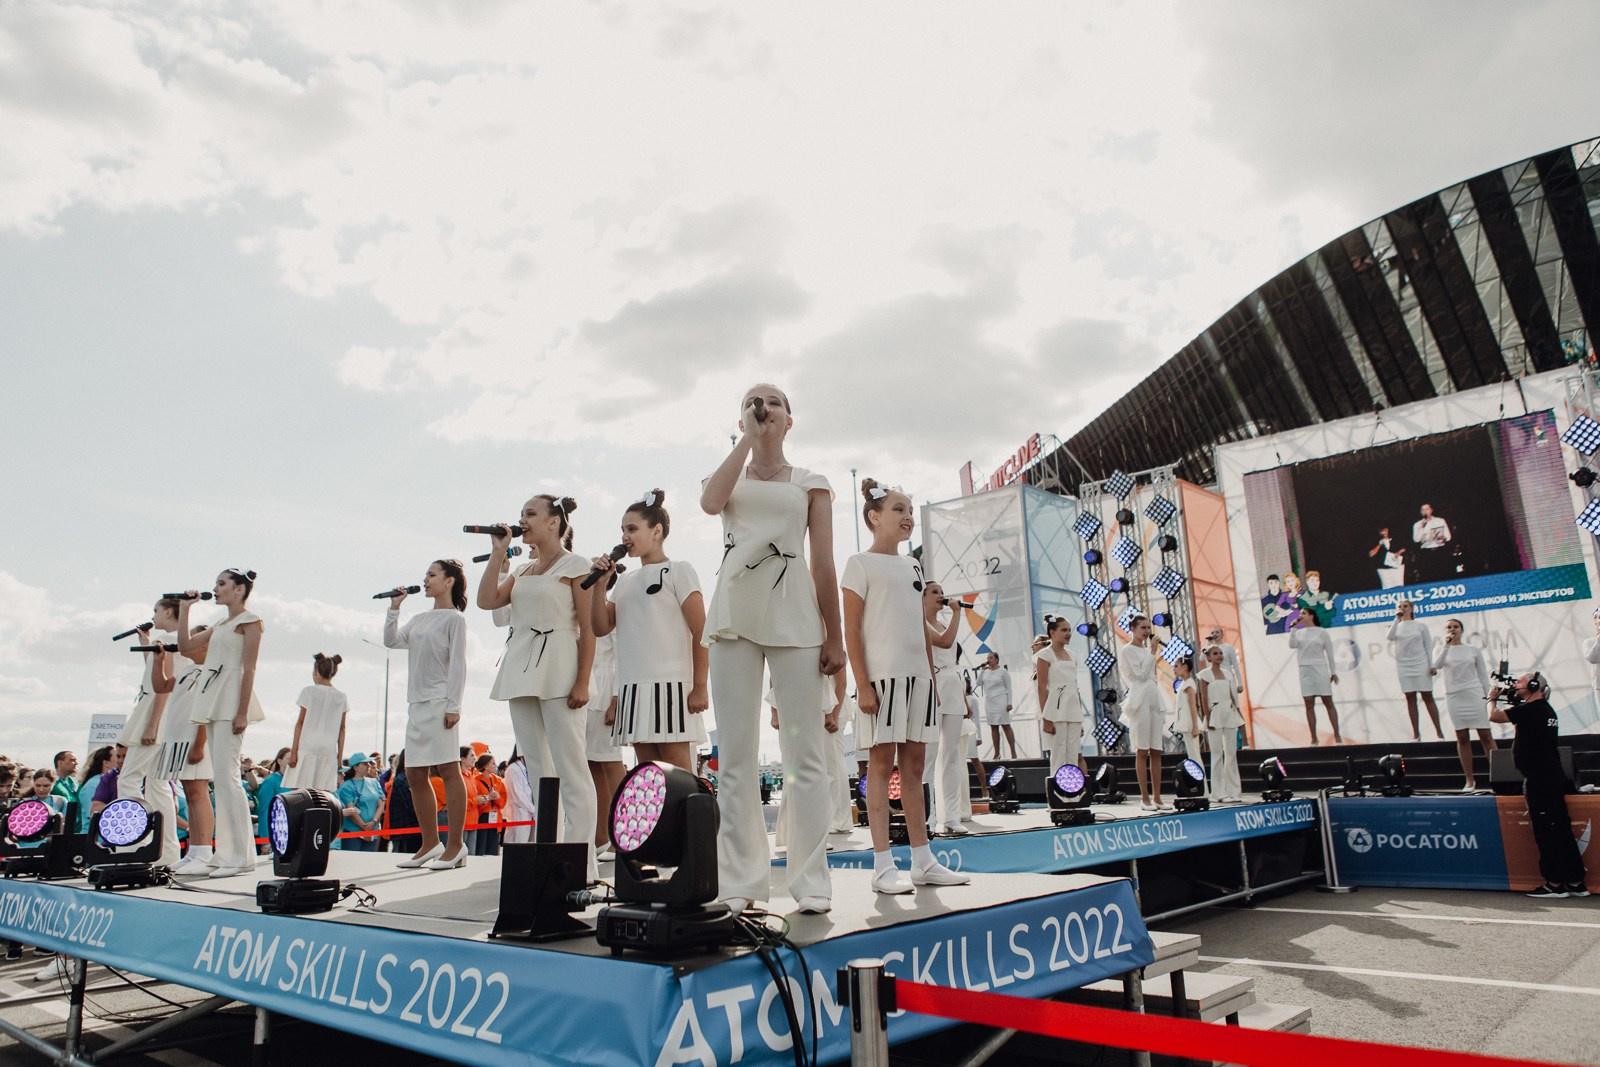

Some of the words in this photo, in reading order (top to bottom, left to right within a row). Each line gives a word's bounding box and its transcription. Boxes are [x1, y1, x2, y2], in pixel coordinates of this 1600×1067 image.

[956, 557, 1001, 580] 2022
[1342, 585, 1466, 610] ATOMSKILLS-2020
[1447, 595, 1508, 609] УЧАСТНИКОВ
[1518, 587, 1575, 602] ЭКСПЕРТОВ
[96, 732, 117, 740] ДЕЛО
[1235, 811, 1267, 831] ATOM
[1265, 806, 1294, 827] SKILLS
[1294, 803, 1315, 822] 2022
[1053, 829, 1105, 860] ATOM
[1103, 823, 1155, 851] SKILLS
[1152, 819, 1188, 842] 2022
[1377, 834, 1478, 849] РОСАТОМ
[27, 897, 76, 939] SKILLS
[68, 904, 114, 948] 2022
[1041, 903, 1133, 972] 2022
[193, 925, 281, 986] ATOM
[277, 938, 399, 1015] SKILLS
[400, 959, 511, 1044] 2022
